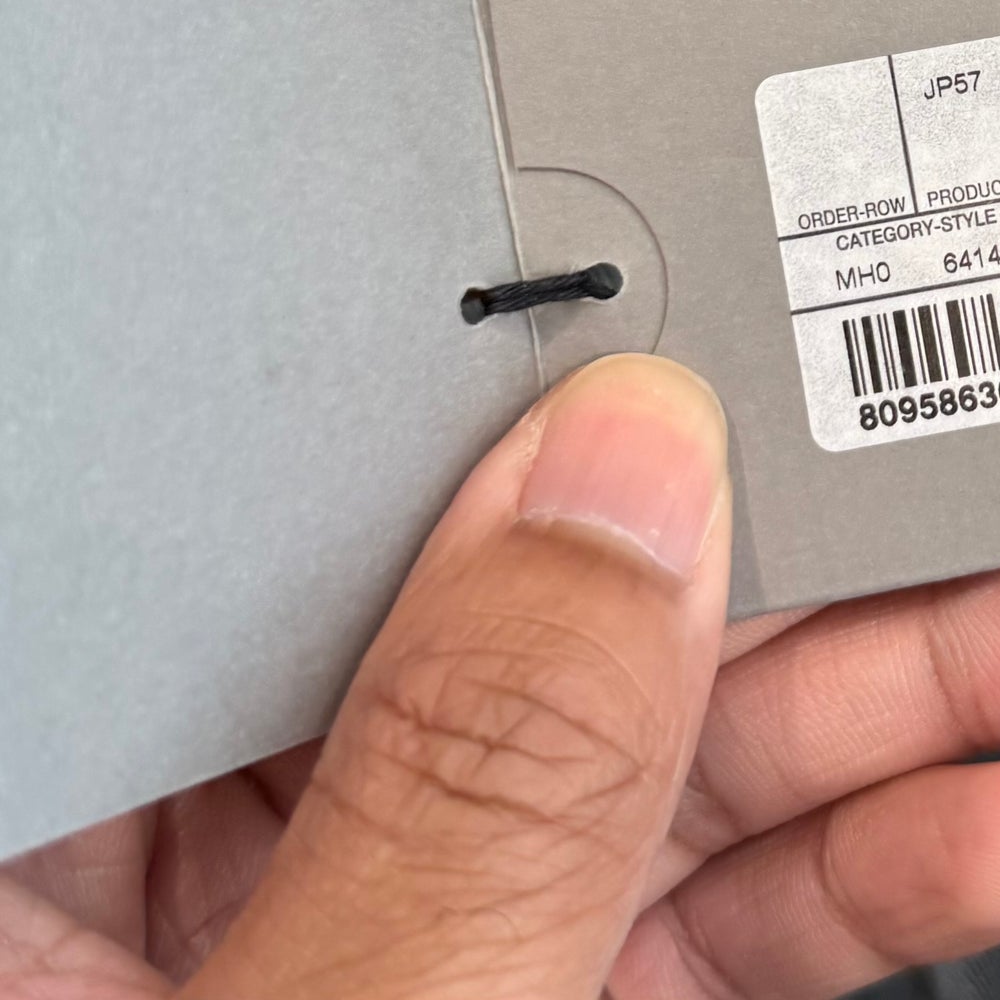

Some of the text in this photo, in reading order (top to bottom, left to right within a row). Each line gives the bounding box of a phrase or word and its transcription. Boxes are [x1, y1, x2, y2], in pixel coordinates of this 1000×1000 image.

[924, 70, 981, 100] JP57
[798, 196, 906, 230] ORDER-ROW
[836, 208, 998, 251] CATEGORY-STYLE
